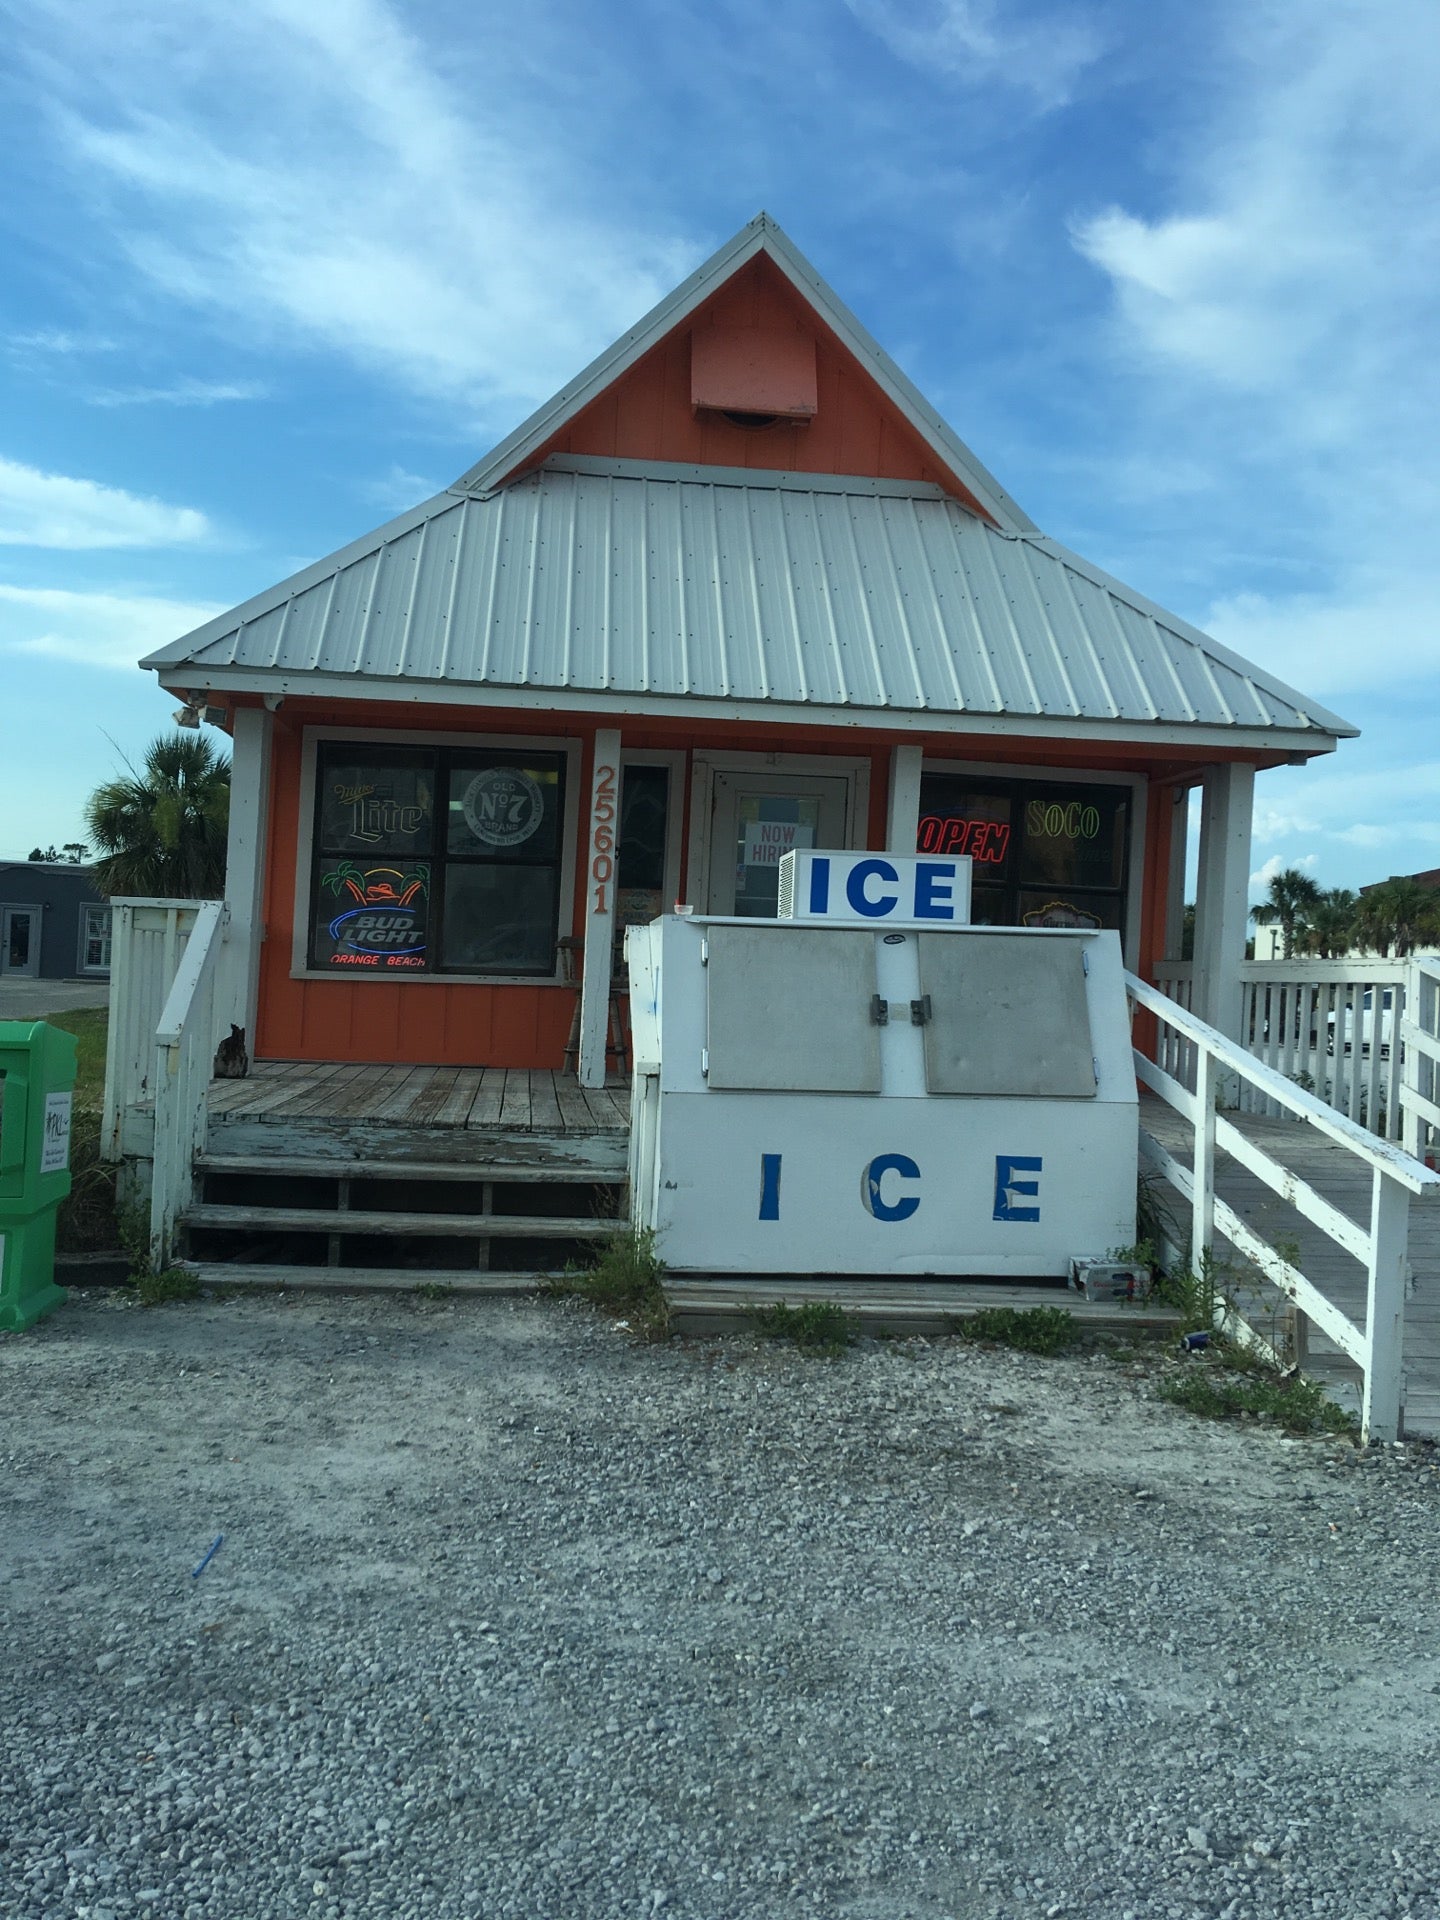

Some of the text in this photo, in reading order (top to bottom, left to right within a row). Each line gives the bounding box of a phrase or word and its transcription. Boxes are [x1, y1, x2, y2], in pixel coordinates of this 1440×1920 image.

[492, 783, 516, 792] OLD
[349, 799, 423, 843] Lite
[484, 821, 519, 832] BRAND
[592, 765, 616, 914] 25601
[761, 825, 796, 844] NOW
[917, 816, 1010, 863] OPEN
[752, 844, 793, 863] HIRI
[809, 857, 956, 920] ICE
[355, 916, 414, 930] BUD
[342, 929, 424, 944] LIGHT
[330, 954, 380, 965] ORANGE
[758, 1153, 1043, 1222] ICE
